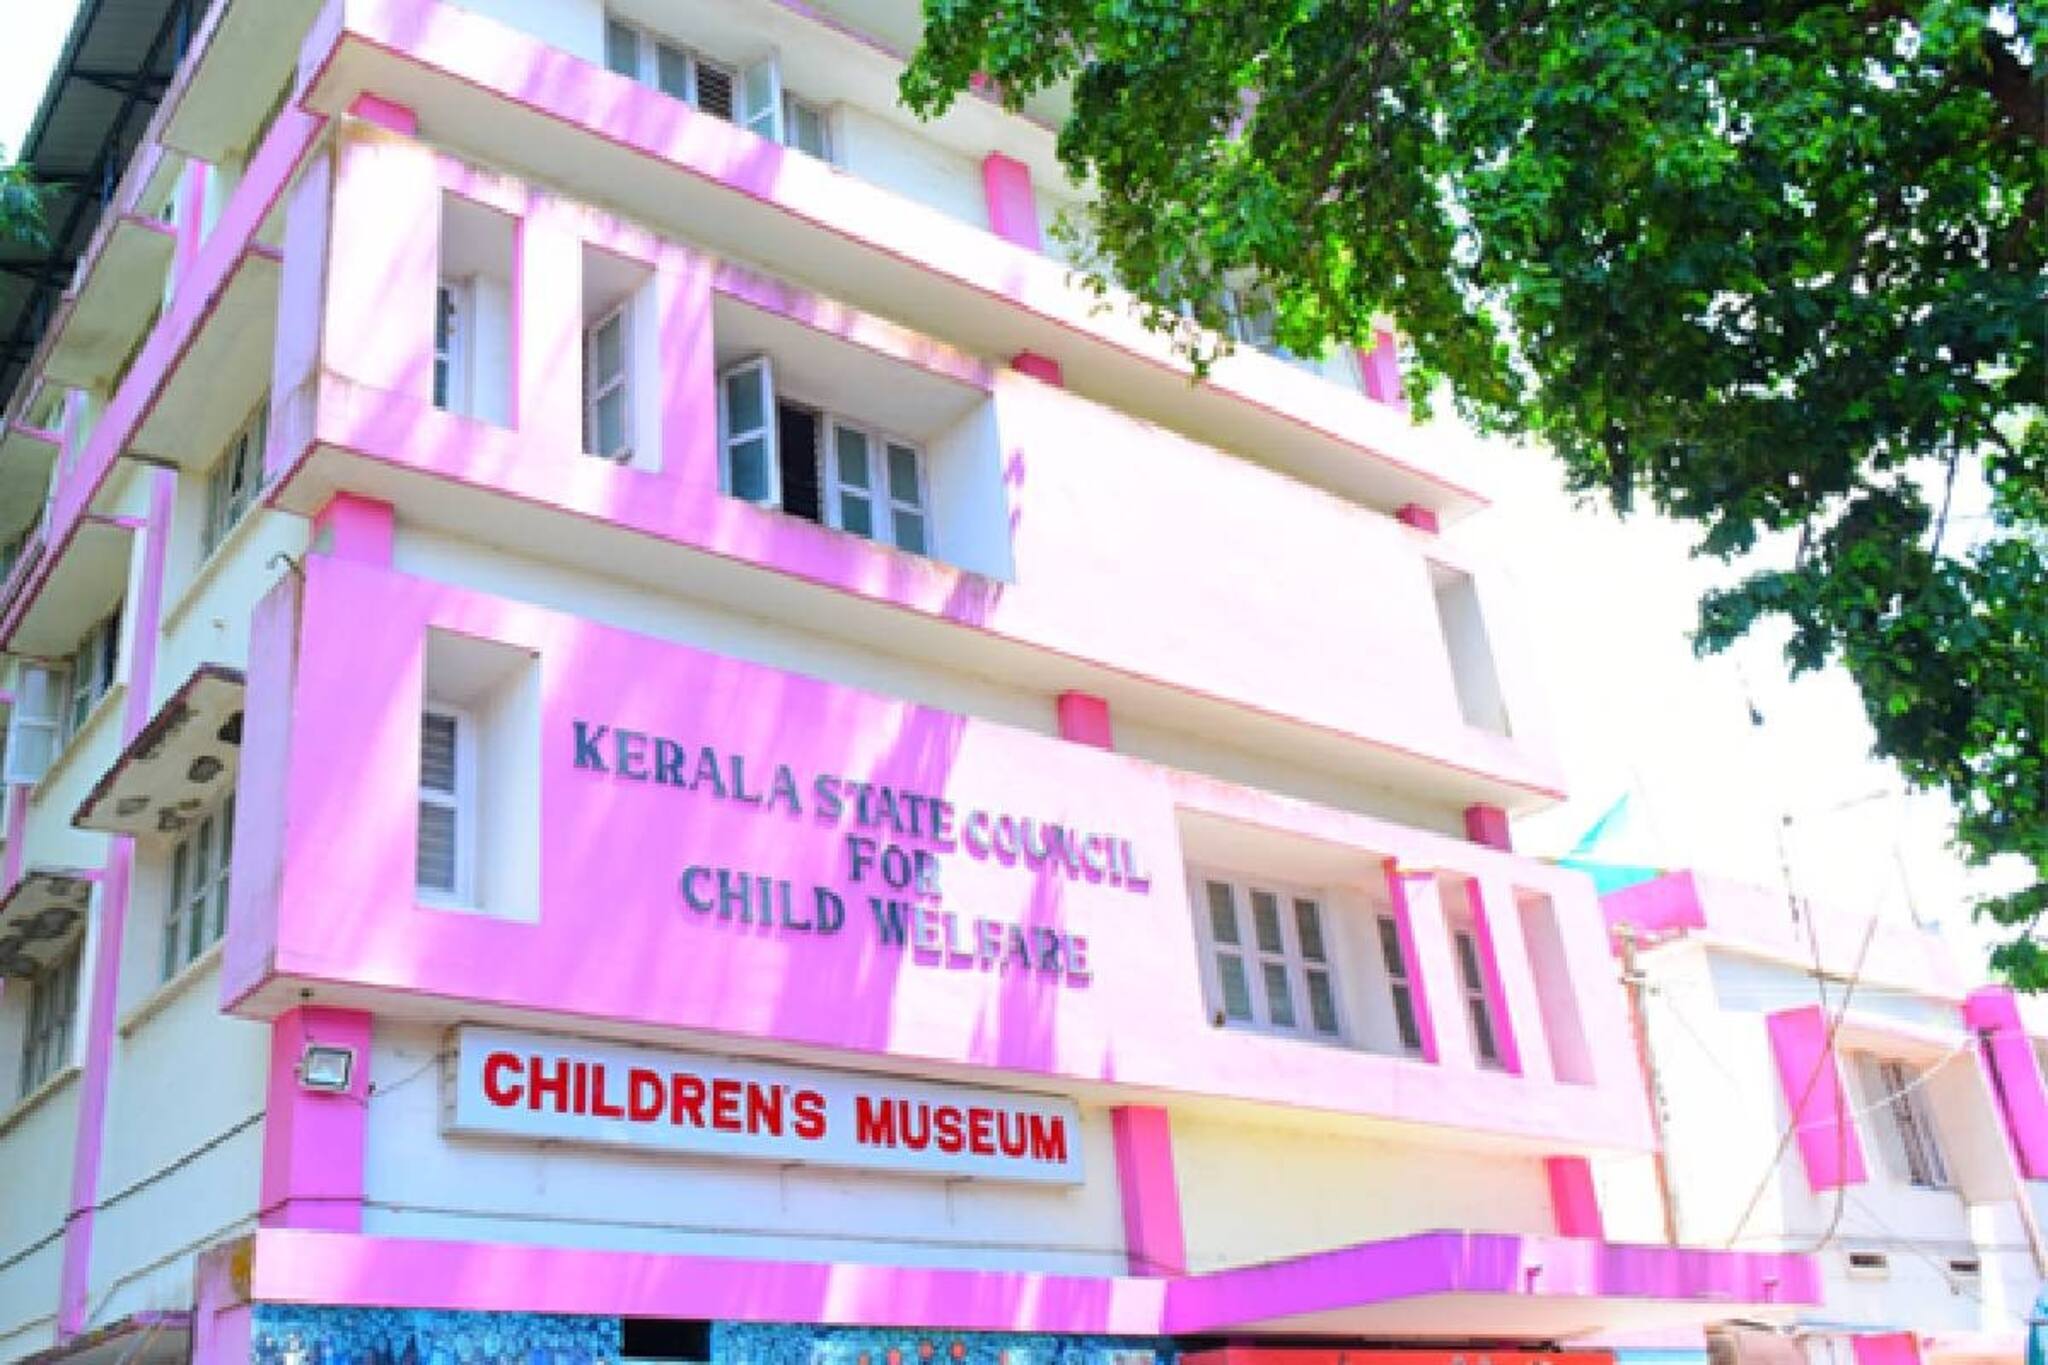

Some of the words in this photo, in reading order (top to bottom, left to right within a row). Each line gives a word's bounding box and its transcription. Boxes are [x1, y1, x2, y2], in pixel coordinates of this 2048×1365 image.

[572, 721, 802, 814] KERALA
[813, 774, 956, 845] STATE
[965, 810, 1151, 893] COUNCIL
[846, 832, 942, 896] FOR
[681, 865, 846, 934] CHILD
[869, 897, 1092, 985] WELFARE
[483, 1051, 827, 1140] CHILDREN'S
[855, 1095, 1068, 1164] MUSEUM
